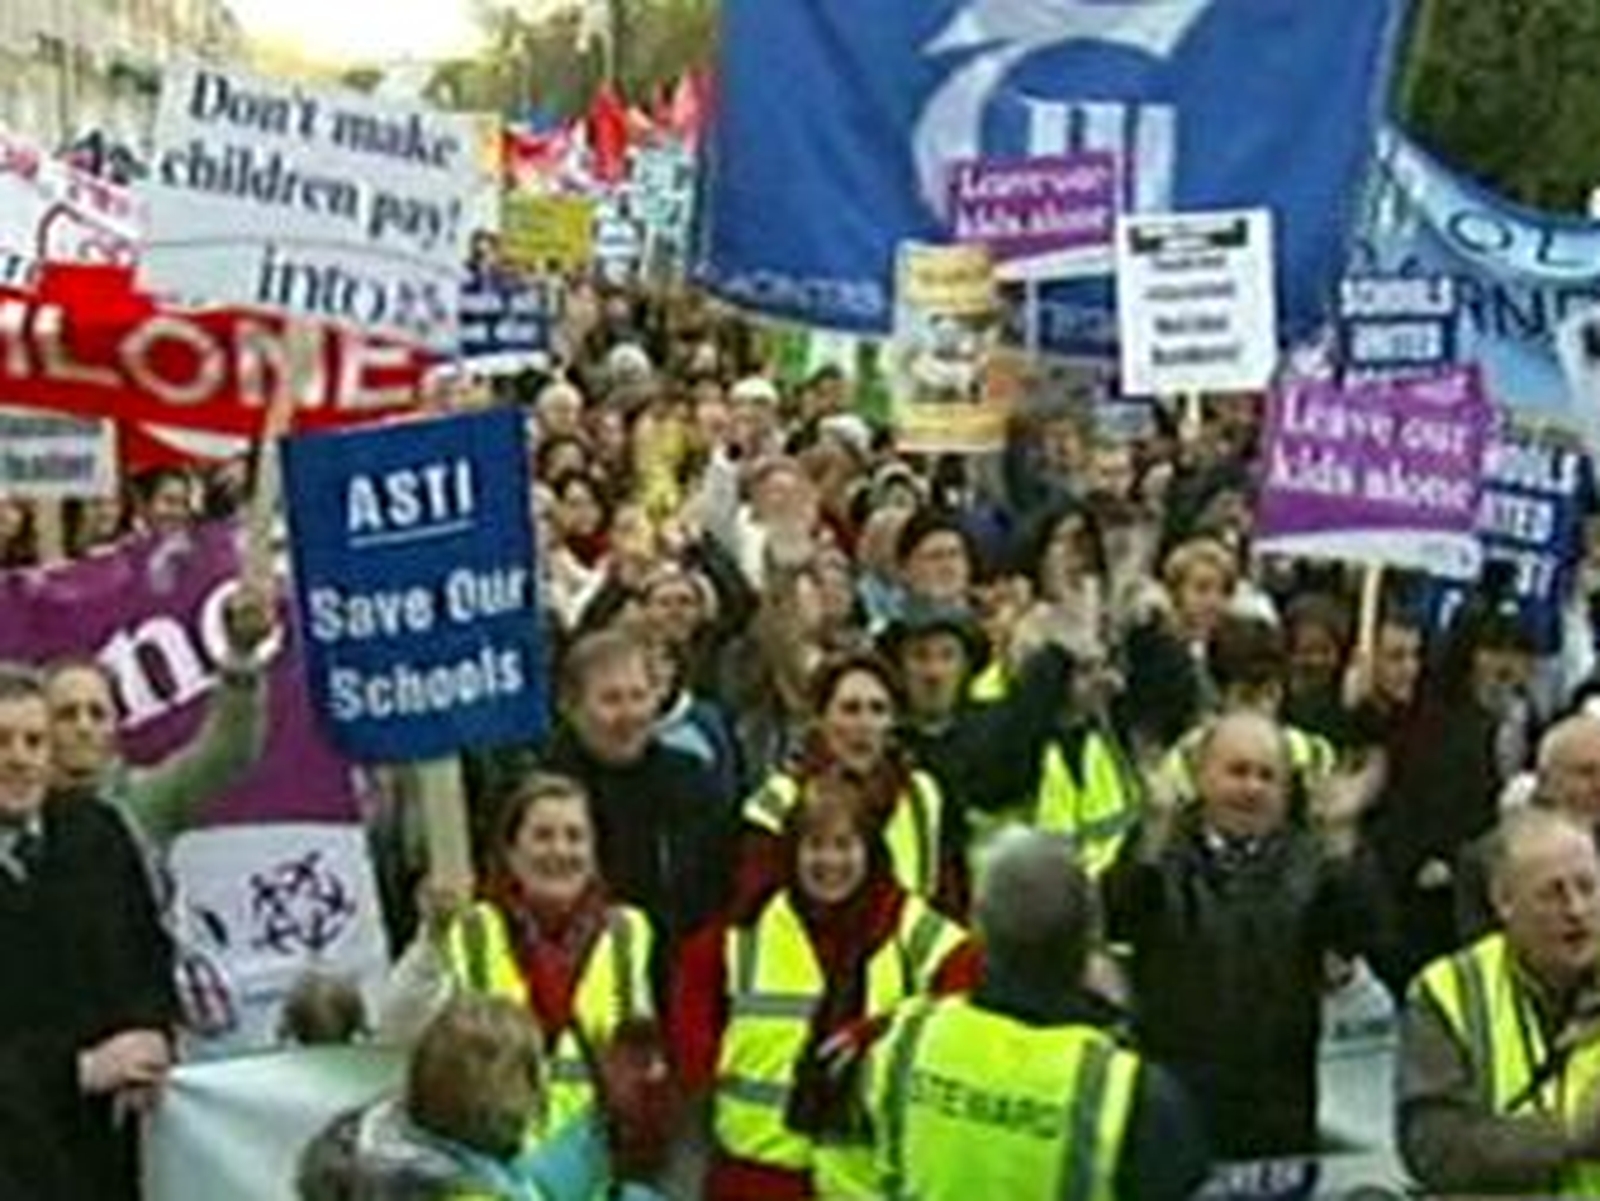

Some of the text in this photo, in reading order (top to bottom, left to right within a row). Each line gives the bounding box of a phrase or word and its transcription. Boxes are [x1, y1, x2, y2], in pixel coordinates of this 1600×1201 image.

[190, 75, 461, 168] Don't make
[160, 141, 359, 220] children
[367, 194, 463, 250] pay!
[1283, 384, 1470, 456] Leave our
[346, 459, 474, 533] ASTI
[1267, 438, 1476, 516] kids alone
[309, 565, 528, 643] Save Our
[330, 646, 524, 723] Schools
